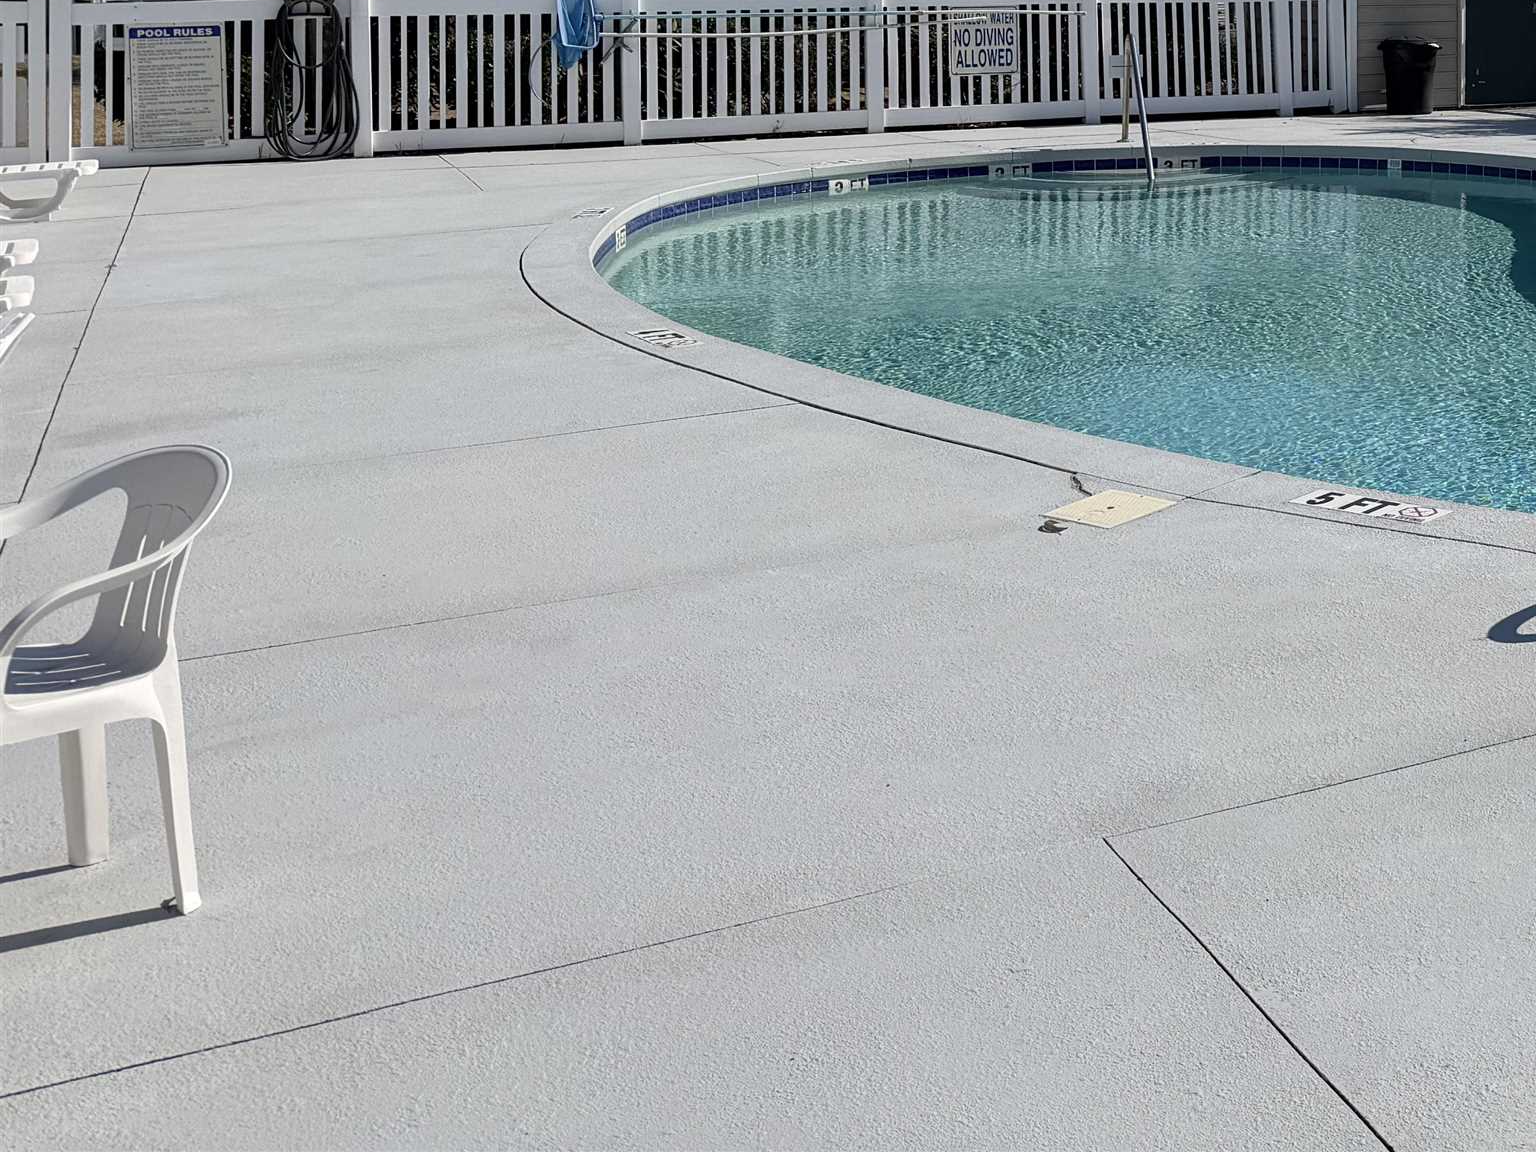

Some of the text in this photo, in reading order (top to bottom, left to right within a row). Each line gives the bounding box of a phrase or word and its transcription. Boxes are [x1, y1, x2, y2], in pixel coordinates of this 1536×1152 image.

[991, 12, 1014, 25] WATER
[137, 27, 213, 38] POOL RULES
[954, 28, 1014, 47] NO DIVING
[956, 48, 1013, 68] ALLOWED
[1181, 159, 1198, 169] FT
[1306, 491, 1400, 515] 5 FT
